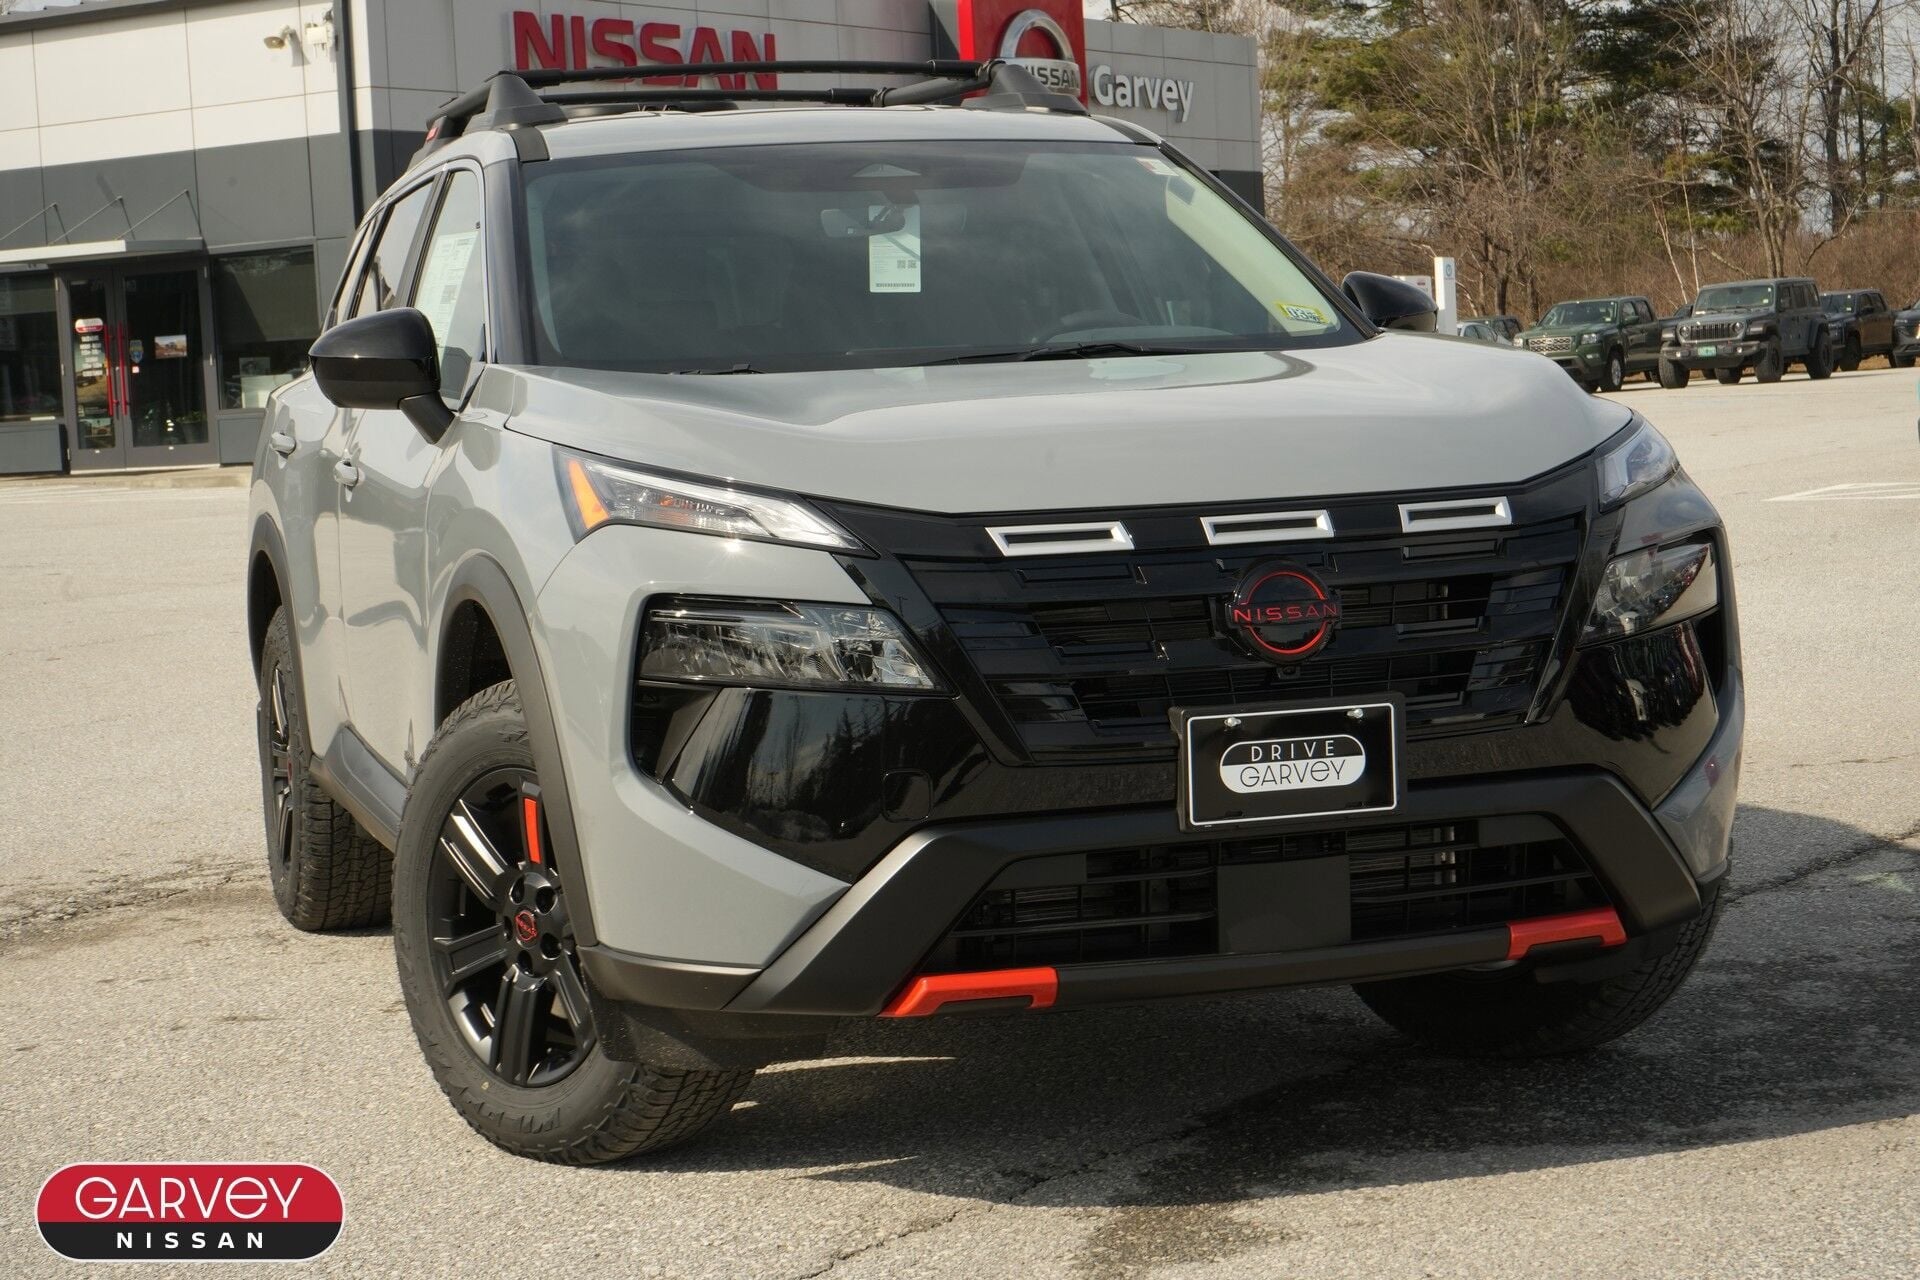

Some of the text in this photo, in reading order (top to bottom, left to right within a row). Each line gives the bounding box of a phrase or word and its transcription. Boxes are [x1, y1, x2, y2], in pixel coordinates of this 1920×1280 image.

[513, 11, 778, 91] NISSAN
[1093, 64, 1194, 122] Garvey
[1233, 603, 1337, 622] NISSAN
[1251, 740, 1335, 762] DRIVE
